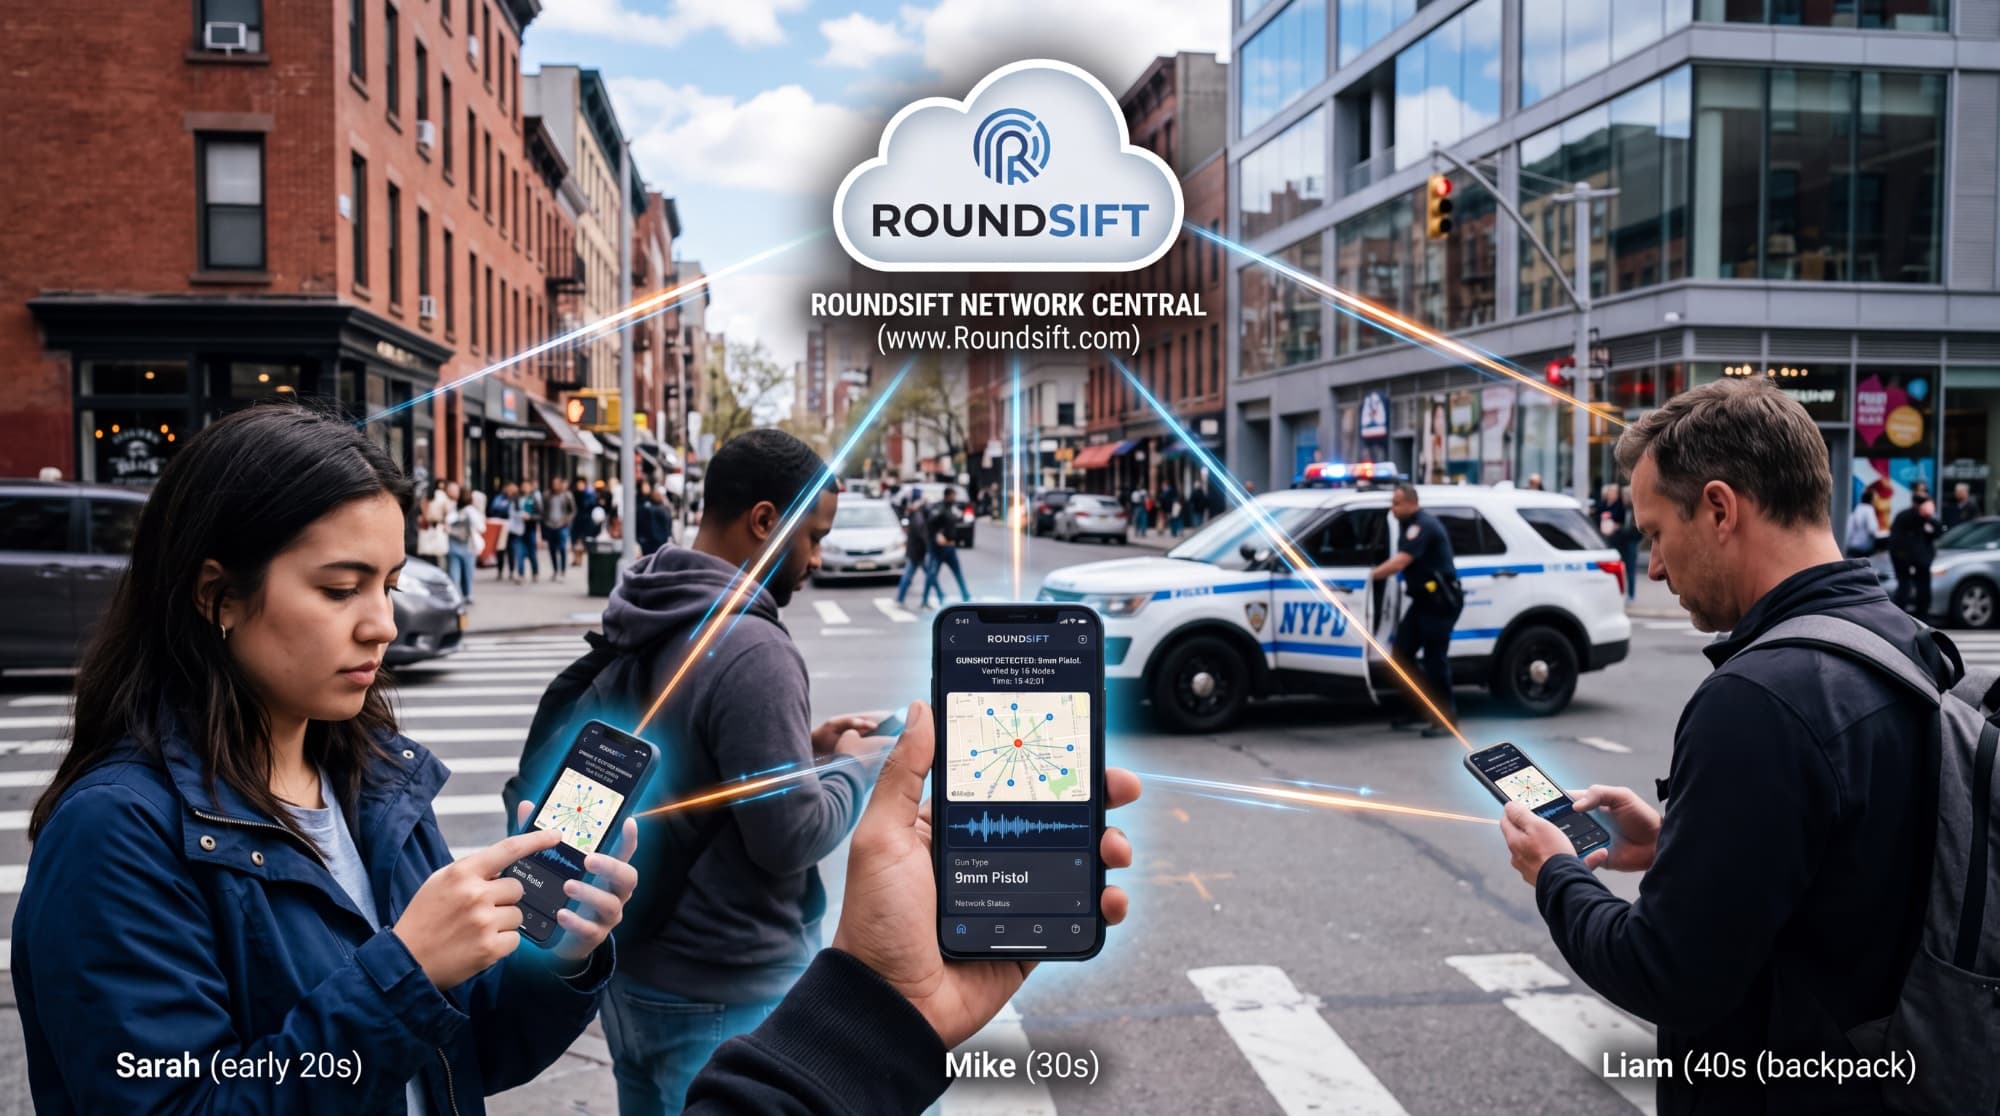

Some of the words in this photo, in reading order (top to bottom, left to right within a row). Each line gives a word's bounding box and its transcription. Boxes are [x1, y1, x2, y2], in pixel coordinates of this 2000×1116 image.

[1279, 602, 1348, 637] NYPD
[987, 634, 1050, 644] ROUNDSIFT
[955, 656, 994, 665] GUNSHOT
[1009, 667, 1020, 677] by
[1031, 667, 1056, 676] Nodes
[954, 858, 970, 867] Gun
[971, 858, 989, 869] Type
[954, 871, 988, 884] 9mm
[992, 871, 1029, 884] Pistol
[954, 899, 986, 908] Network
[986, 899, 1011, 908] Status
